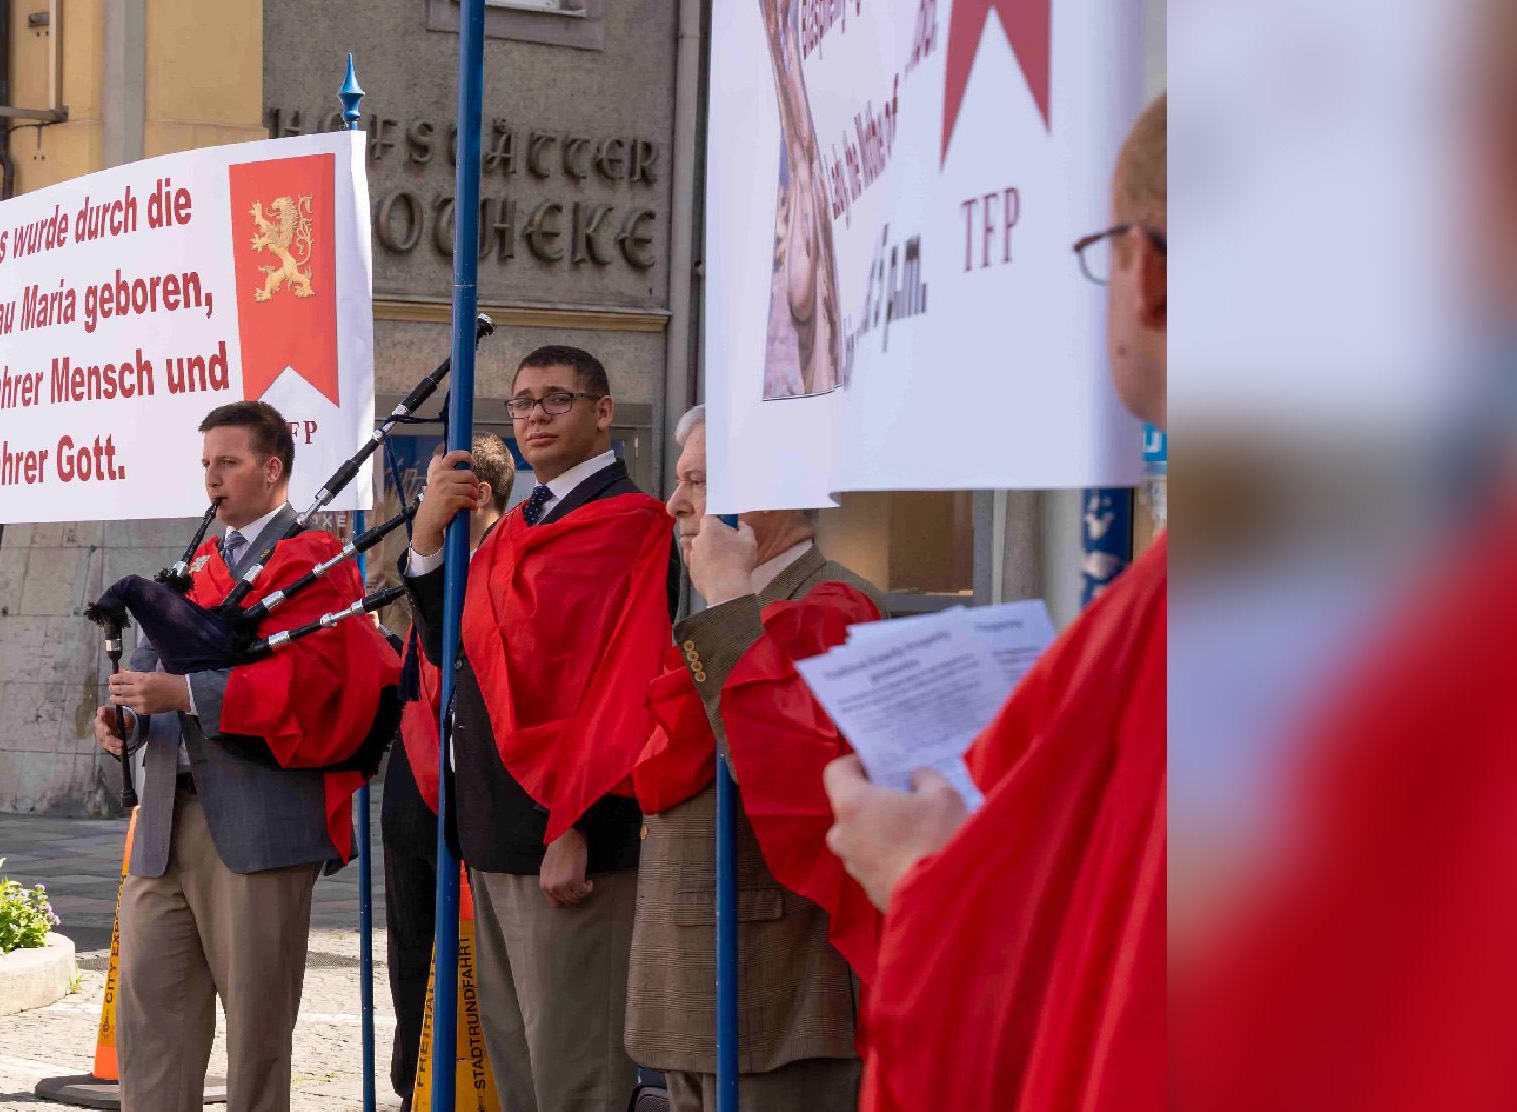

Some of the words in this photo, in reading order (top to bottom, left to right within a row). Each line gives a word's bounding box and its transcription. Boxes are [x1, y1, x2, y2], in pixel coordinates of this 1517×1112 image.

[13, 204, 69, 259] wurde
[74, 185, 138, 244] durch
[147, 177, 192, 230] die
[376, 190, 658, 270] OTHEKE
[961, 186, 1021, 273] TFP
[20, 279, 77, 332] Maria
[84, 267, 213, 334] geboren,
[50, 347, 155, 404] Mensch
[165, 340, 230, 394] und
[56, 434, 126, 483] Gott.
[286, 420, 318, 445] FP
[104, 965, 118, 1004] CITY
